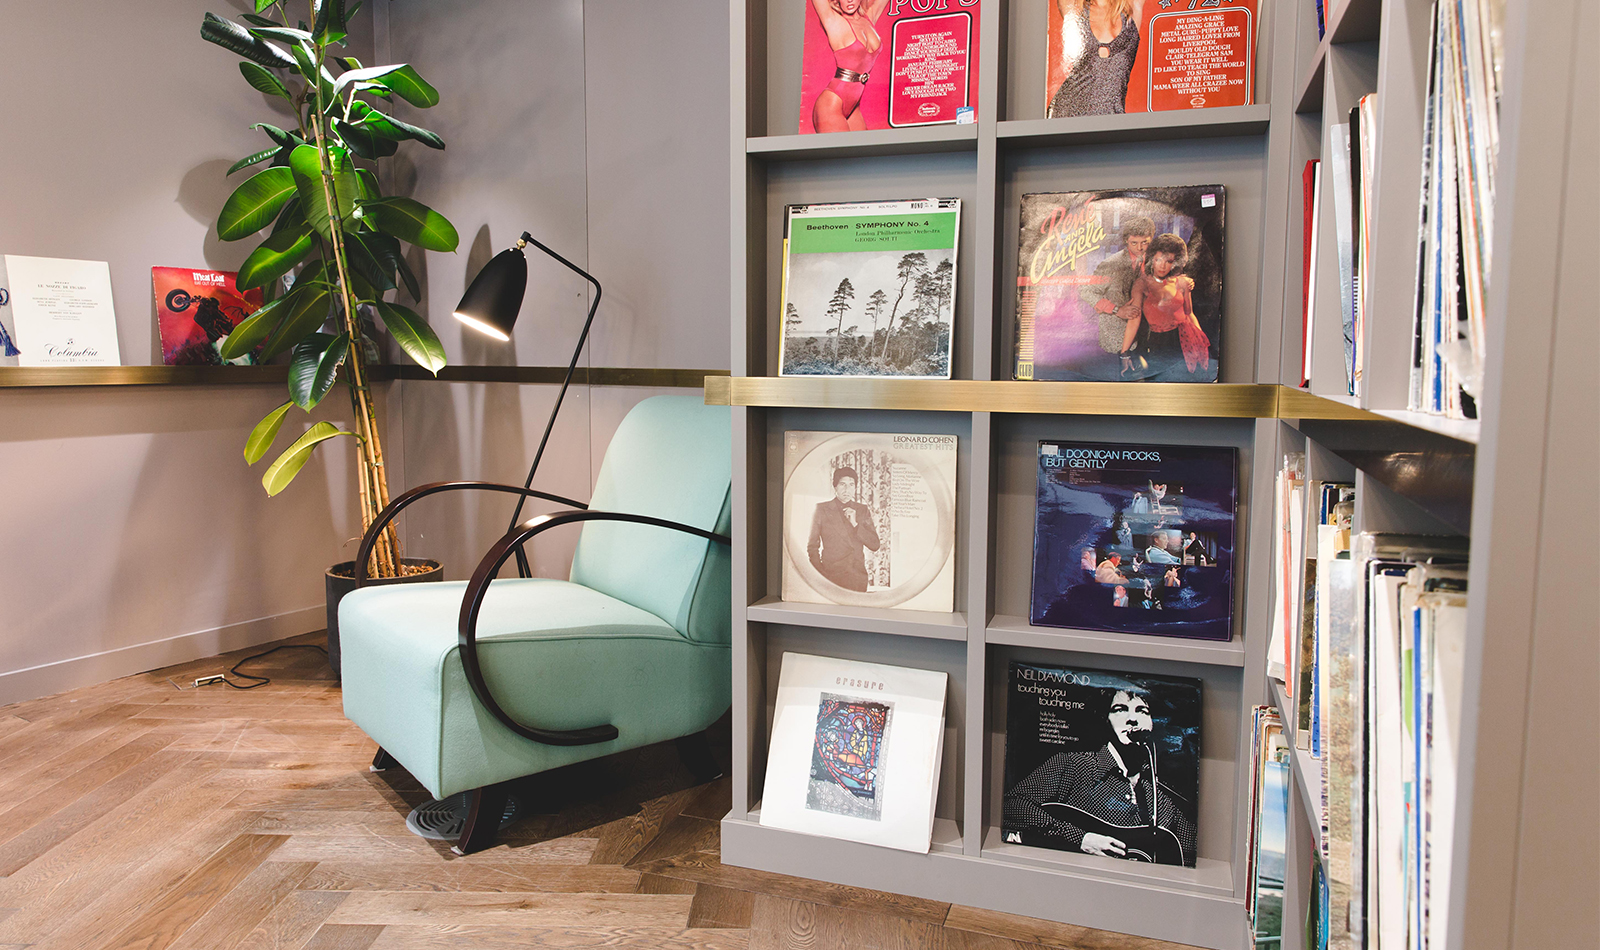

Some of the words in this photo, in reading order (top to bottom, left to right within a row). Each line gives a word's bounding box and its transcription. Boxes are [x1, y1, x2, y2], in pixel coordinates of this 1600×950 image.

[1186, 15, 1224, 24] DING-A-LING
[1175, 22, 1202, 30] AMAZING
[1183, 39, 1217, 48] LIVERPOOL
[1168, 47, 1193, 55] MOULDY
[1177, 87, 1207, 95] WITHOUT
[855, 221, 905, 229] SYMPHONY
[1040, 194, 1096, 249] René
[1063, 227, 1085, 243] AND
[1030, 221, 1107, 285] Angela
[44, 343, 98, 357] Columbia
[892, 442, 934, 450] GREATEST
[928, 436, 954, 444] COHEN
[1066, 448, 1120, 460] DOONICAN
[1122, 450, 1162, 463] ROCKS,
[1045, 458, 1066, 467] BUT
[1068, 459, 1108, 469] GENTLY
[836, 676, 884, 690] erasure
[1016, 668, 1038, 681] NEIL
[1038, 670, 1091, 686] DIAMOND
[1017, 682, 1050, 697] touching
[1051, 689, 1067, 697] you
[1038, 696, 1072, 710] touching
[1072, 702, 1085, 710] me
